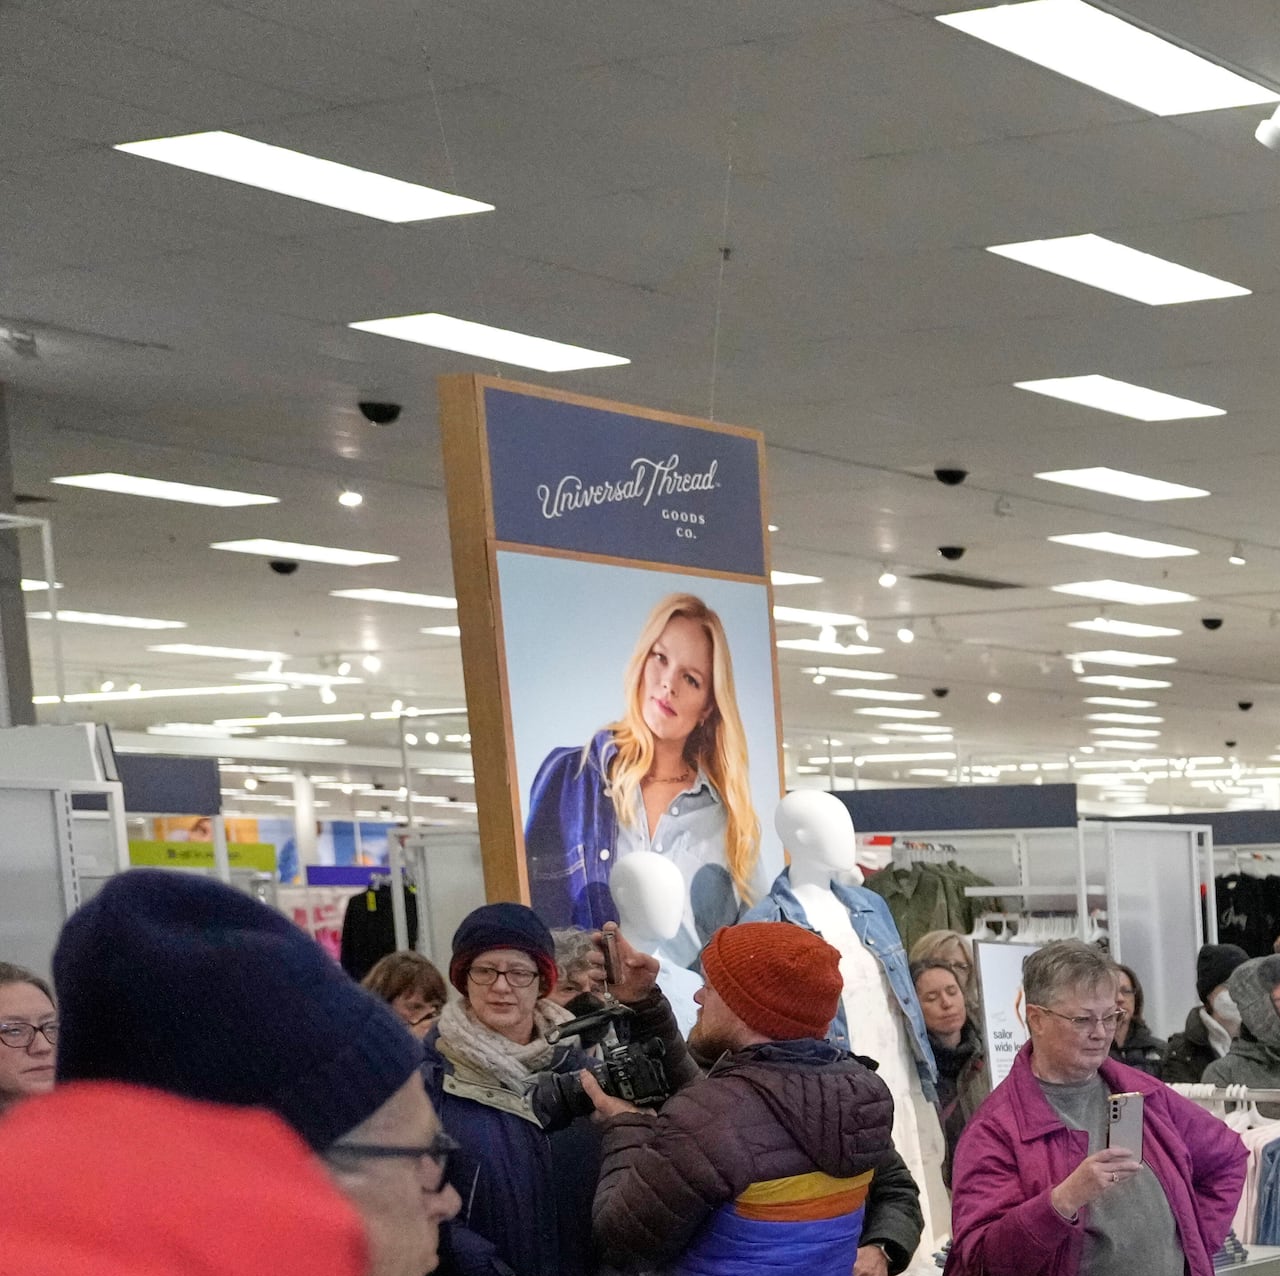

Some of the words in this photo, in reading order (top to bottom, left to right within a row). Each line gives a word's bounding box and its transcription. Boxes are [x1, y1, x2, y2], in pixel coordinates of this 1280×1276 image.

[537, 465, 646, 519] Universal
[631, 454, 719, 506] Thread
[661, 509, 705, 525] GOODS
[676, 527, 698, 539] CO.
[993, 1029, 1013, 1040] sailor
[994, 1042, 1013, 1053] wide
